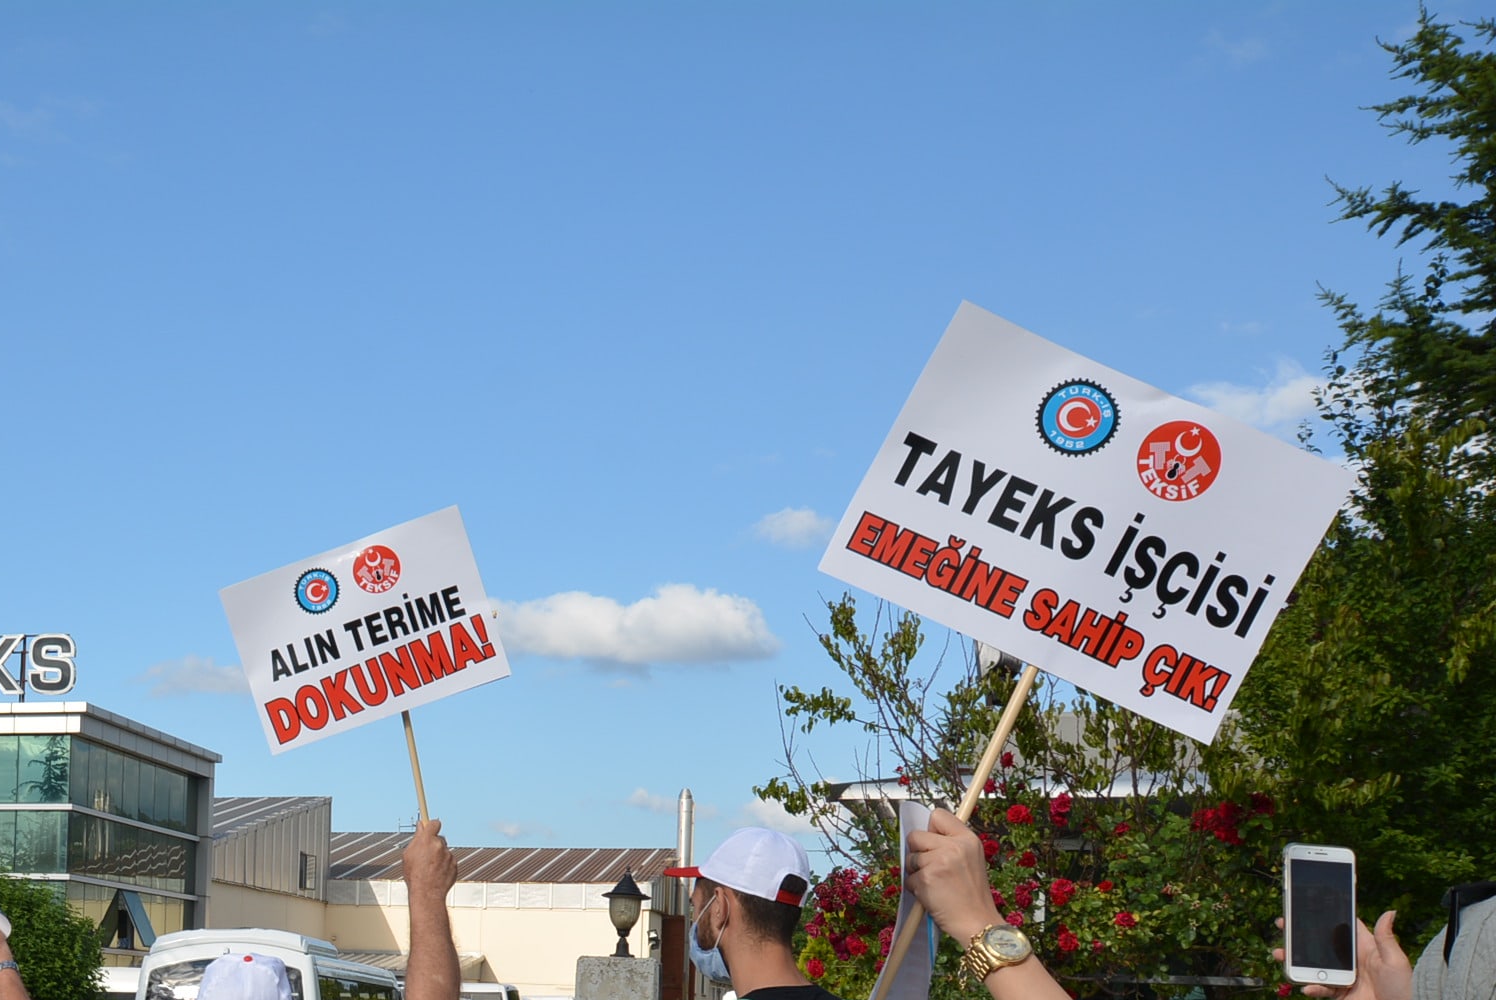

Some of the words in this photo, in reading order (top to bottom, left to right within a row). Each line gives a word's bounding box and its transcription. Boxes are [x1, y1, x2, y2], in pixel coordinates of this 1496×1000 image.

[845, 510, 1029, 619] EMEĞİNE
[1022, 587, 1145, 667] SAHİP
[1139, 643, 1232, 713] ÇIK!
[894, 431, 1104, 560] TAYEKS
[1104, 512, 1276, 639] İŞÇİSİ
[263, 613, 497, 745] DOKUNMA!
[270, 628, 341, 682] ALIN
[343, 585, 467, 653] TERİME
